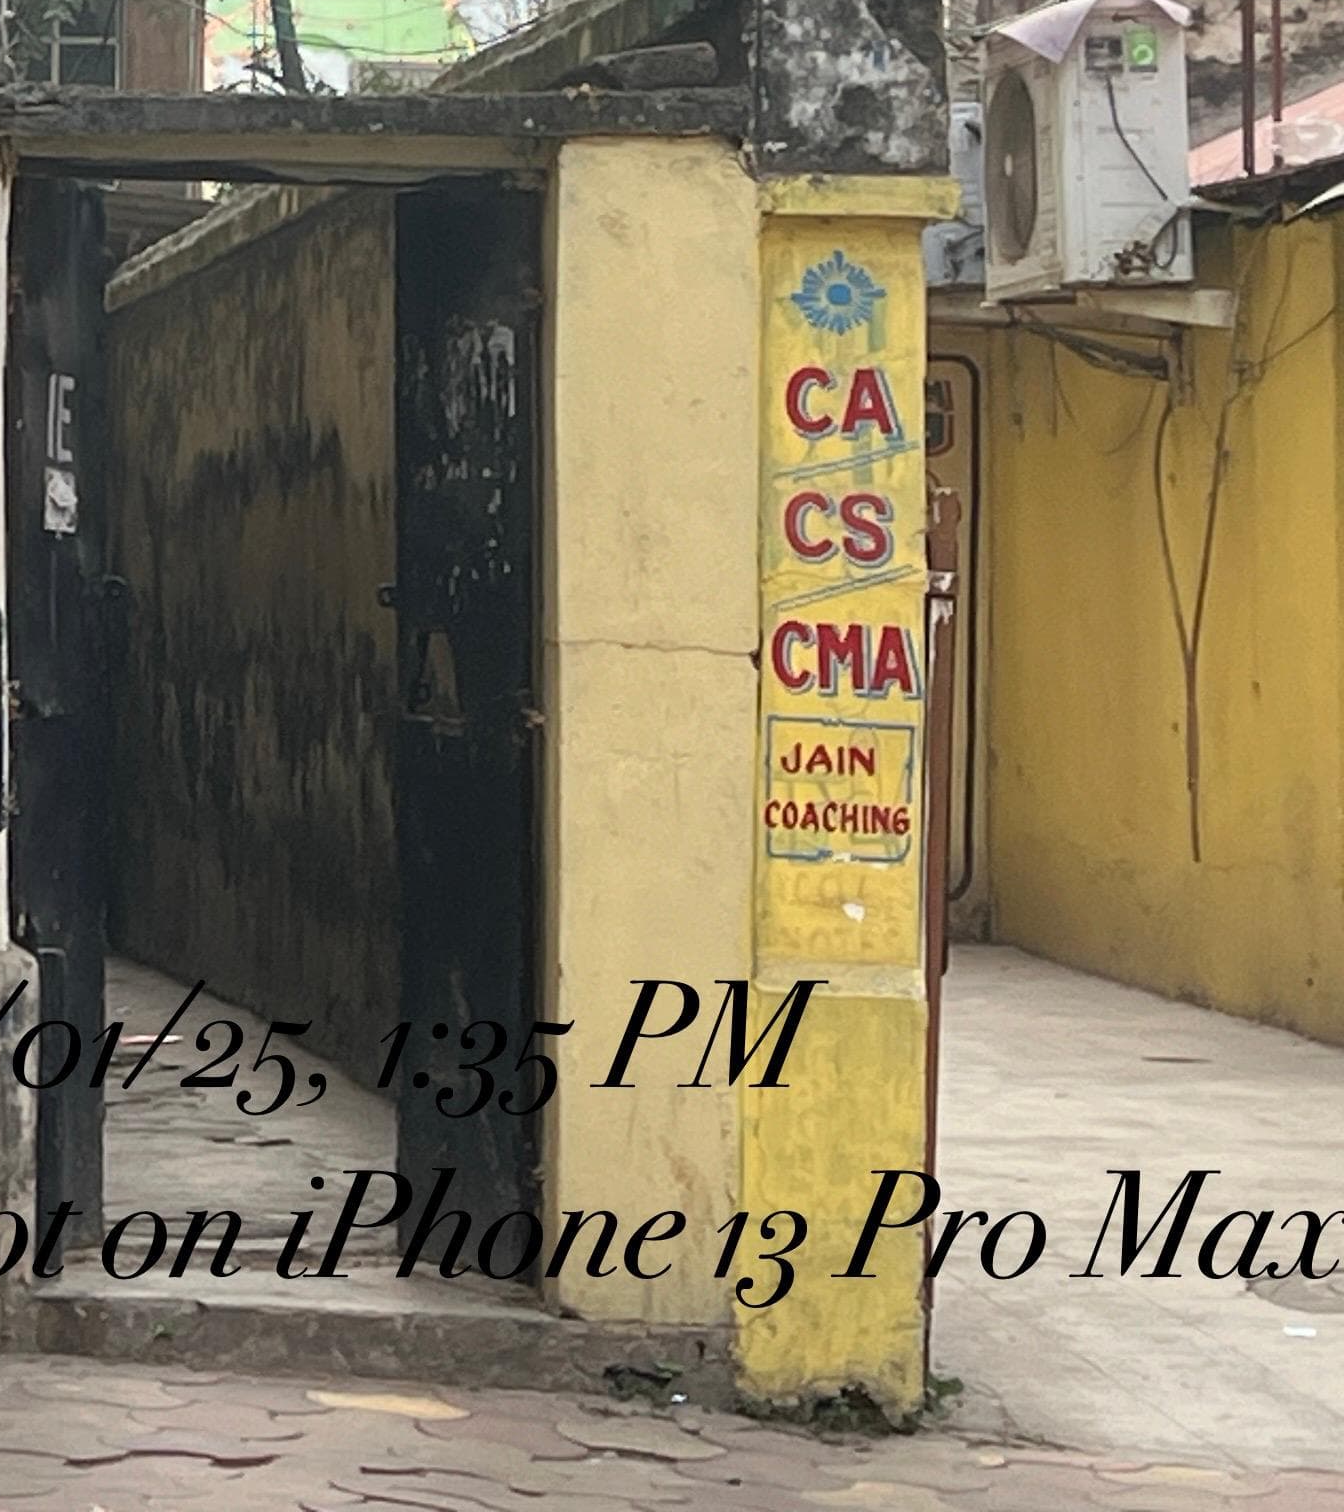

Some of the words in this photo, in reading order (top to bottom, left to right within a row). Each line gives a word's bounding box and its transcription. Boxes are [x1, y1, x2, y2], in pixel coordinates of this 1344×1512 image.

[784, 364, 905, 441] CA
[783, 490, 894, 569] CS
[770, 619, 924, 701] CMA
[780, 742, 876, 777] JAIN
[764, 799, 912, 837] COACHING
